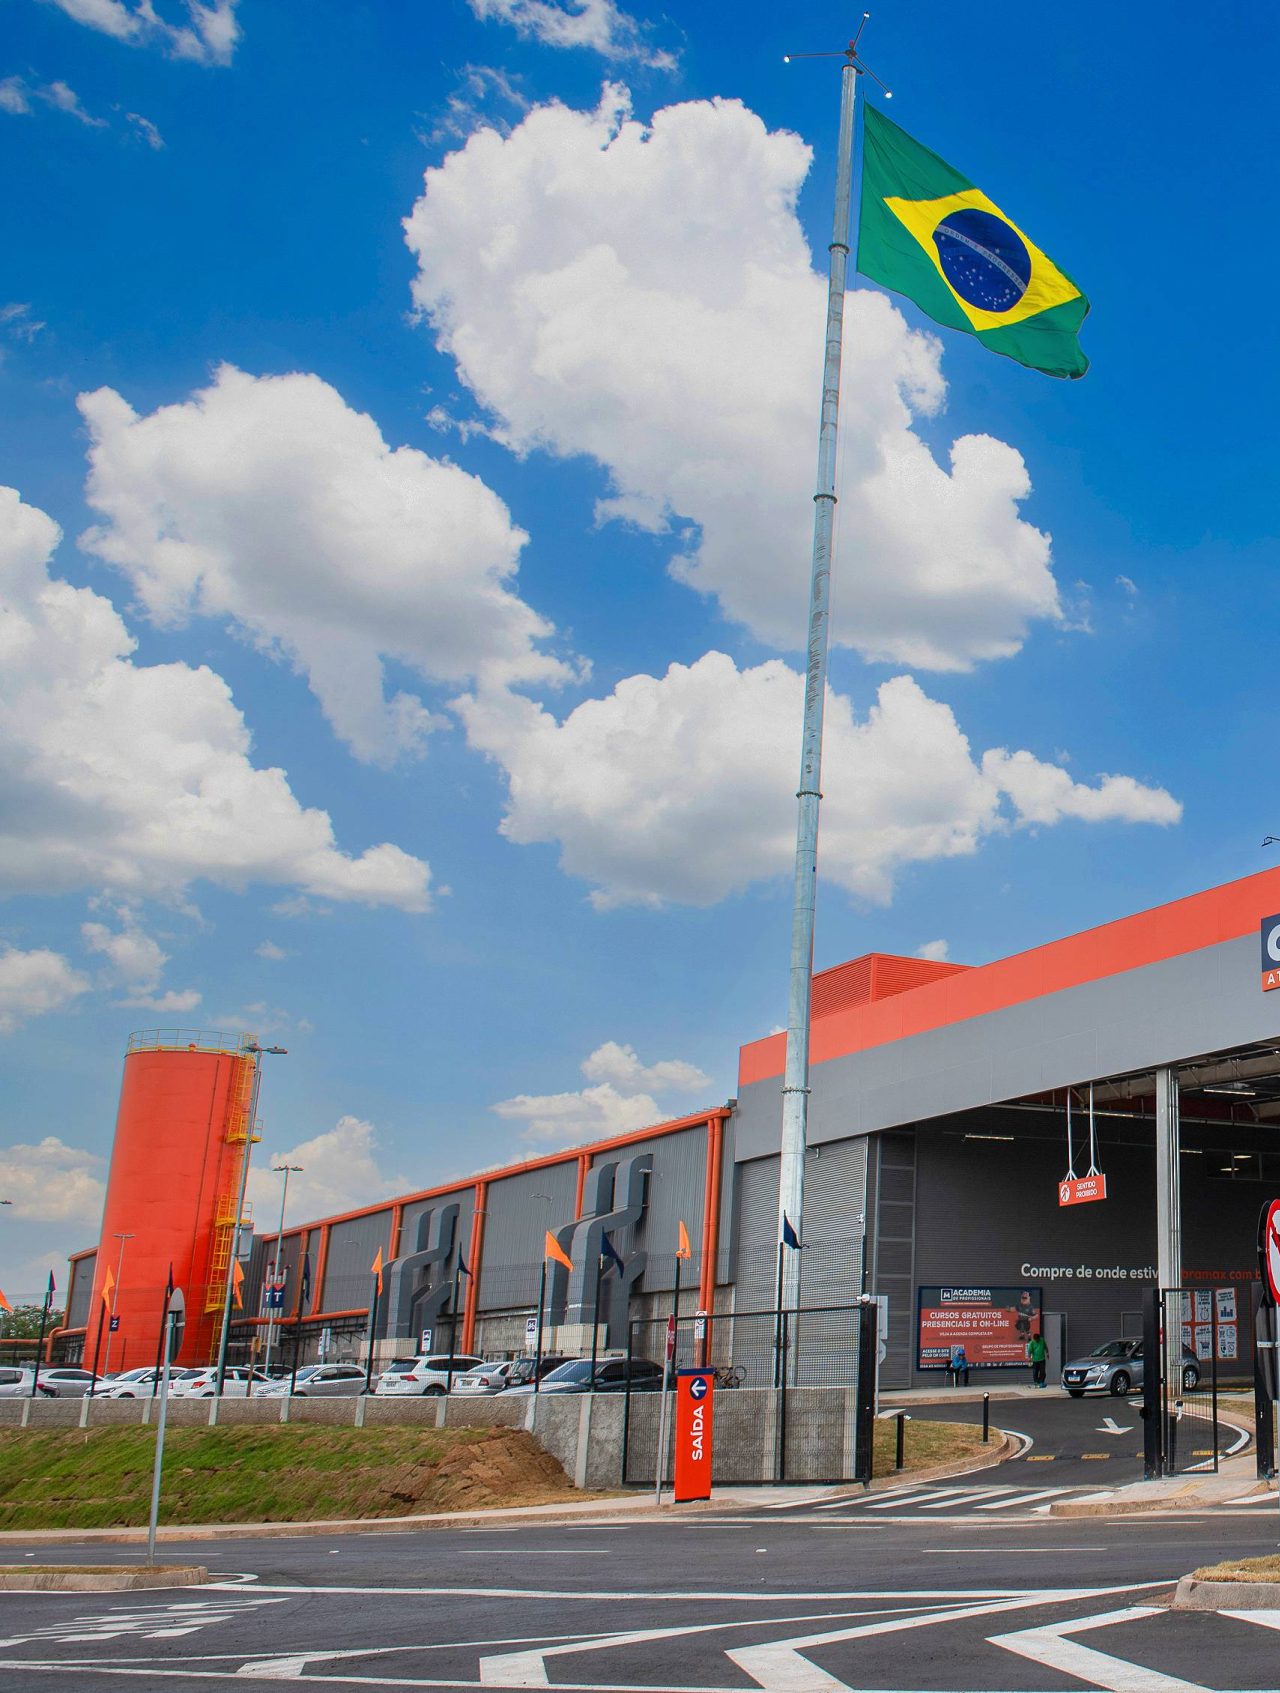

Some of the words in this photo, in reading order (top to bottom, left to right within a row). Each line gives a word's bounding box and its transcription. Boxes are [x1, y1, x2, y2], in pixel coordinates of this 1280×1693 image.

[1076, 1181, 1096, 1190] SENTIDO
[1076, 1189, 1098, 1198] PROIBIDO
[1021, 1263, 1073, 1280] Compre
[1076, 1265, 1092, 1278] de
[1095, 1266, 1127, 1279] onde
[274, 1292, 282, 1301] T
[961, 1311, 1002, 1319] GRATUITOS
[922, 1320, 970, 1328] PRESENCIAIS
[690, 1405, 704, 1461] SAÍDA
